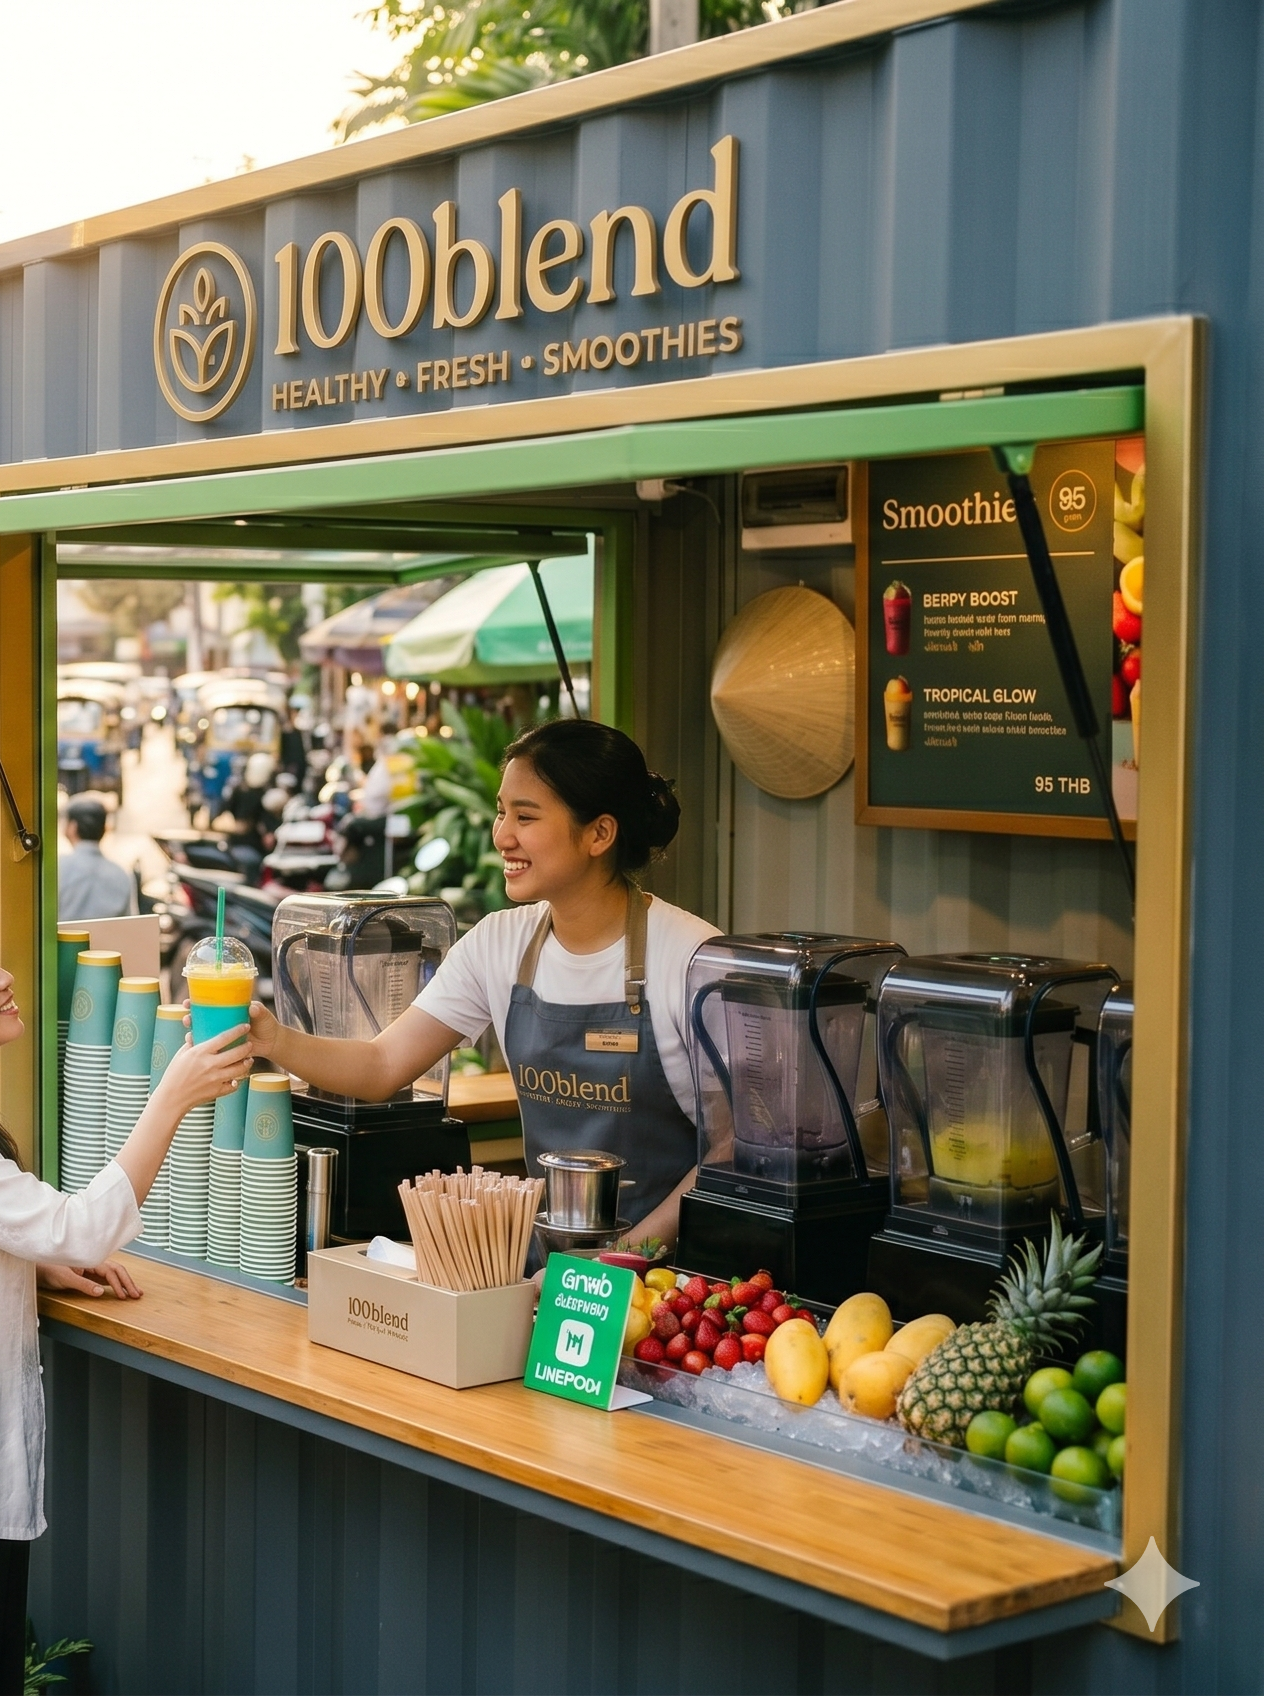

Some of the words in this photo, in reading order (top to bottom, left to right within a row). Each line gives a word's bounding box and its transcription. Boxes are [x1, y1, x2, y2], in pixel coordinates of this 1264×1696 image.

[274, 135, 740, 355] 100blend
[272, 368, 390, 411] HEALTHY
[417, 350, 510, 393] FRESH
[542, 316, 743, 377] SMOOTHIES
[882, 491, 1018, 530] Smoothie
[970, 590, 1018, 607] BOOST
[923, 688, 990, 703] TROPICAL
[993, 688, 1037, 704] GLOW
[1035, 776, 1053, 793] 95
[1058, 777, 1091, 794] THB
[518, 1064, 631, 1103] 100blend
[348, 1297, 409, 1332] 100blend
